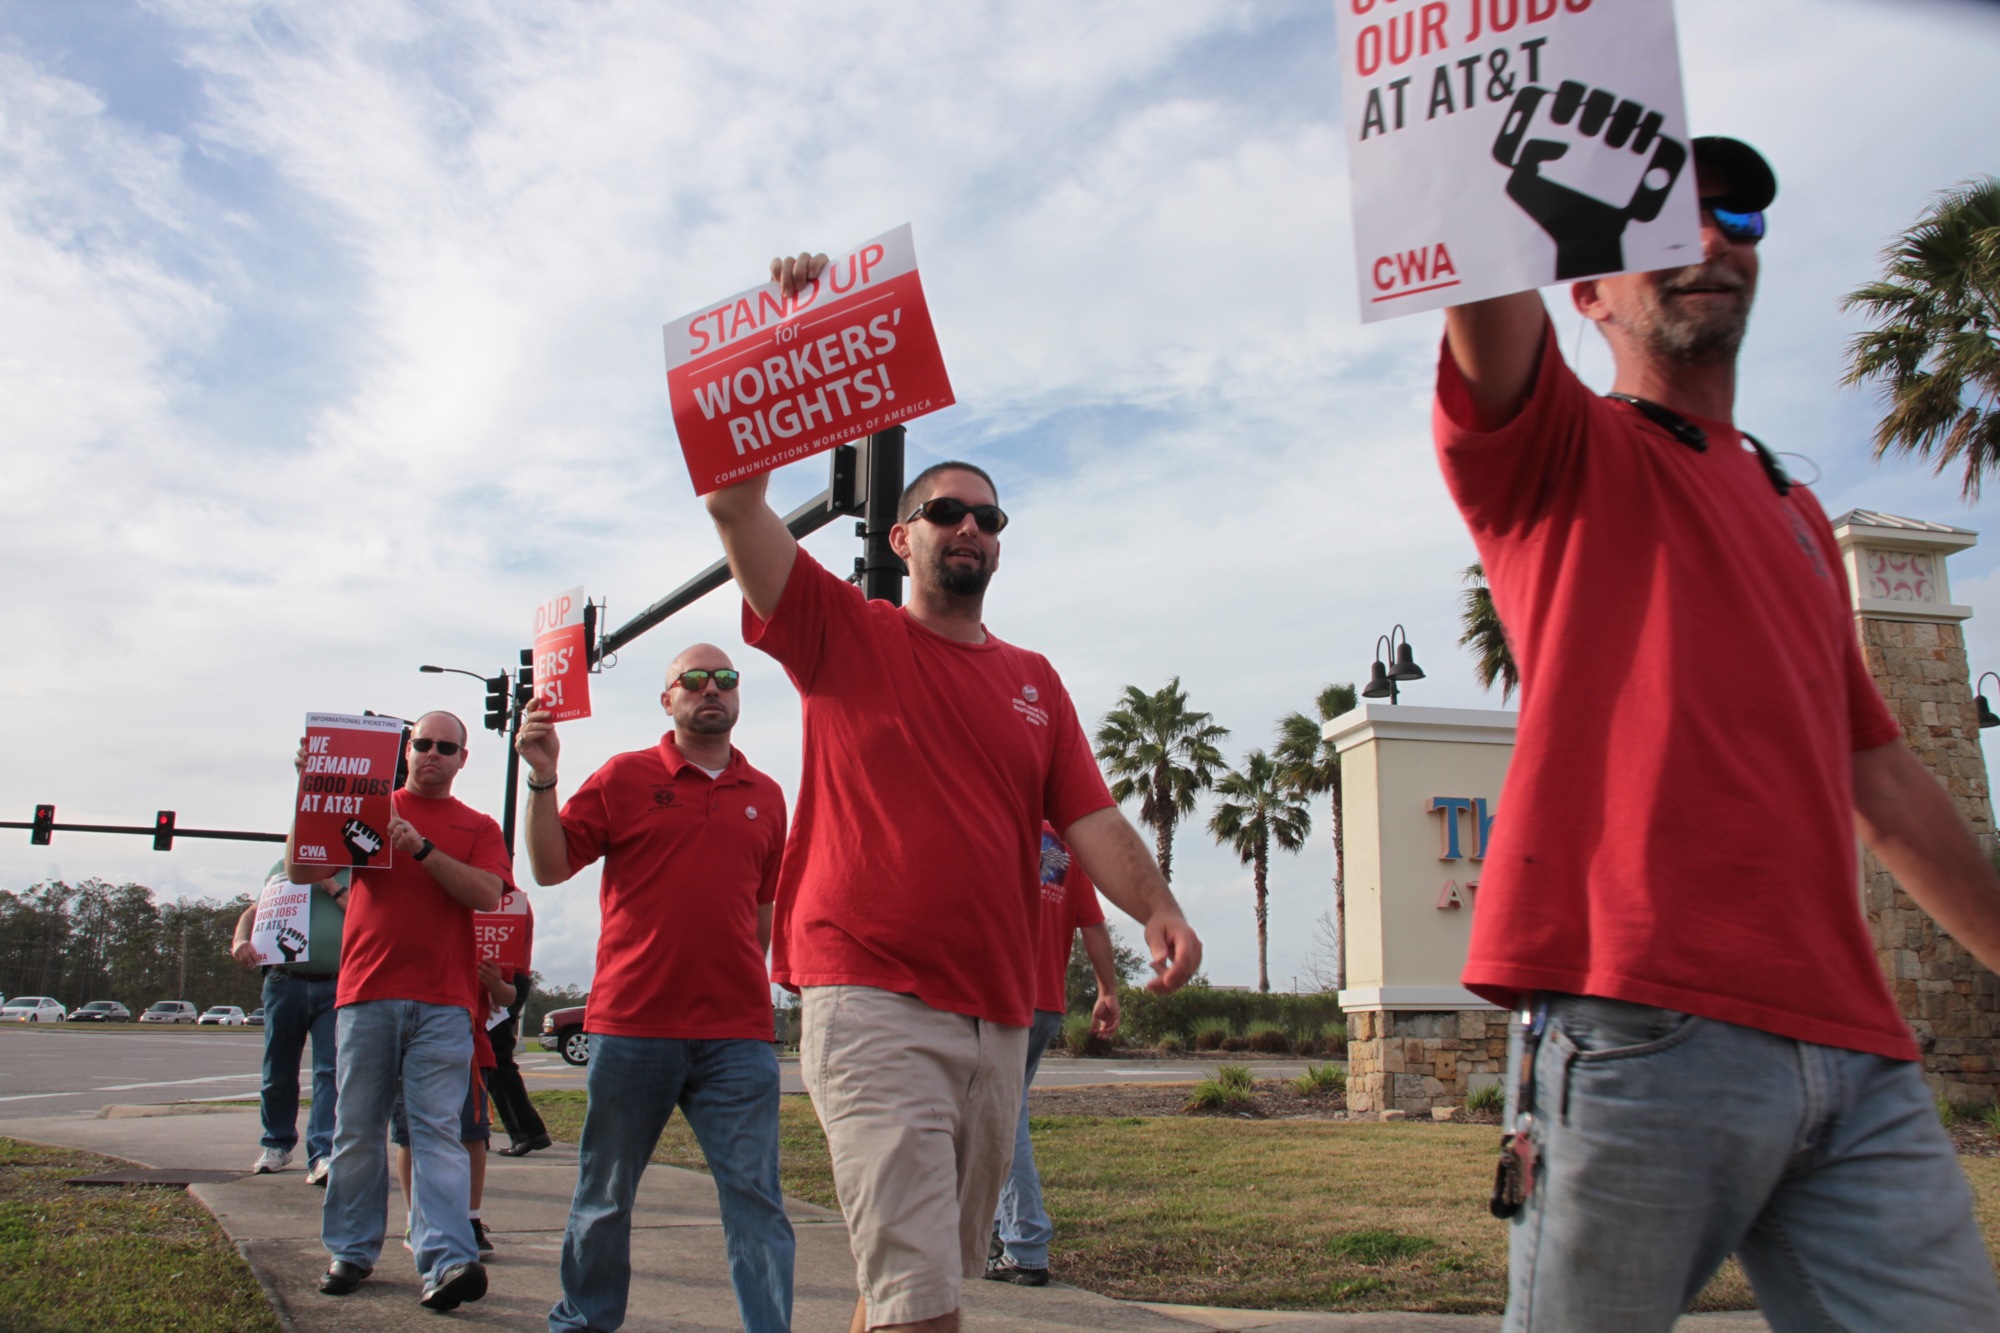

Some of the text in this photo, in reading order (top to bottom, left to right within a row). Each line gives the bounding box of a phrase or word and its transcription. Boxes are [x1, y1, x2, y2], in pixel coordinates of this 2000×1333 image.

[1357, 0, 1593, 77] OUR JO
[1360, 36, 1548, 141] AT AT&T
[828, 243, 885, 294] UP
[1371, 242, 1457, 292] CWA
[774, 322, 801, 346] for
[693, 307, 901, 421] WORKERS'
[728, 363, 895, 456] RIGHTS!
[715, 399, 932, 484] COMMUNICATIONS WORKERS OF AMERICA
[548, 595, 572, 629] UP
[310, 716, 397, 728] INFORMATIONAL PICKETING
[308, 736, 331, 754] WE
[305, 755, 371, 775] DEMAND
[302, 775, 390, 796] GOOD JOBS
[300, 794, 364, 814] AT AT&T
[299, 845, 327, 858] CWA
[260, 893, 309, 911] OUTSOURCE
[257, 906, 298, 922] OUR JOBS
[254, 919, 289, 934] AT AT&T
